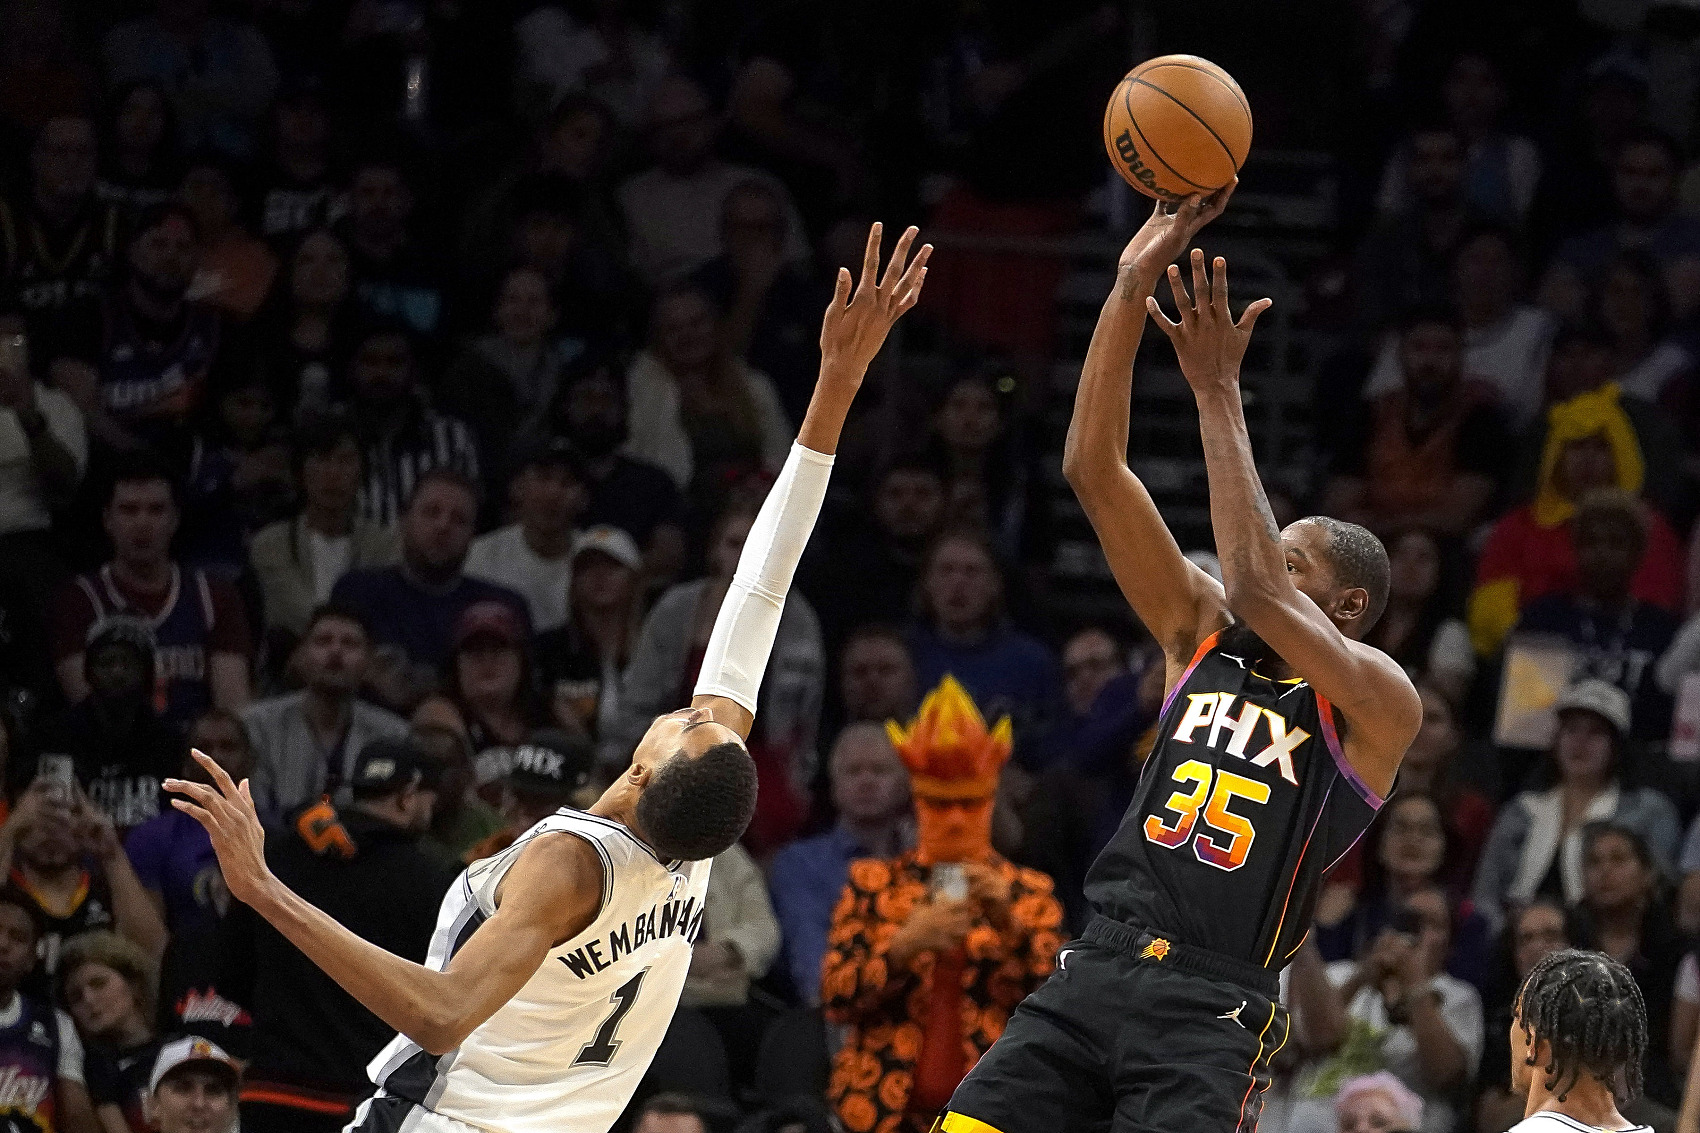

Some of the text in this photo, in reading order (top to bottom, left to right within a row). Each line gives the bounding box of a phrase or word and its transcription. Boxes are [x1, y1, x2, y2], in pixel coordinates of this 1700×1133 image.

[1171, 692, 1311, 786] PHX
[1143, 759, 1271, 872] 35
[568, 966, 652, 1069] 1
